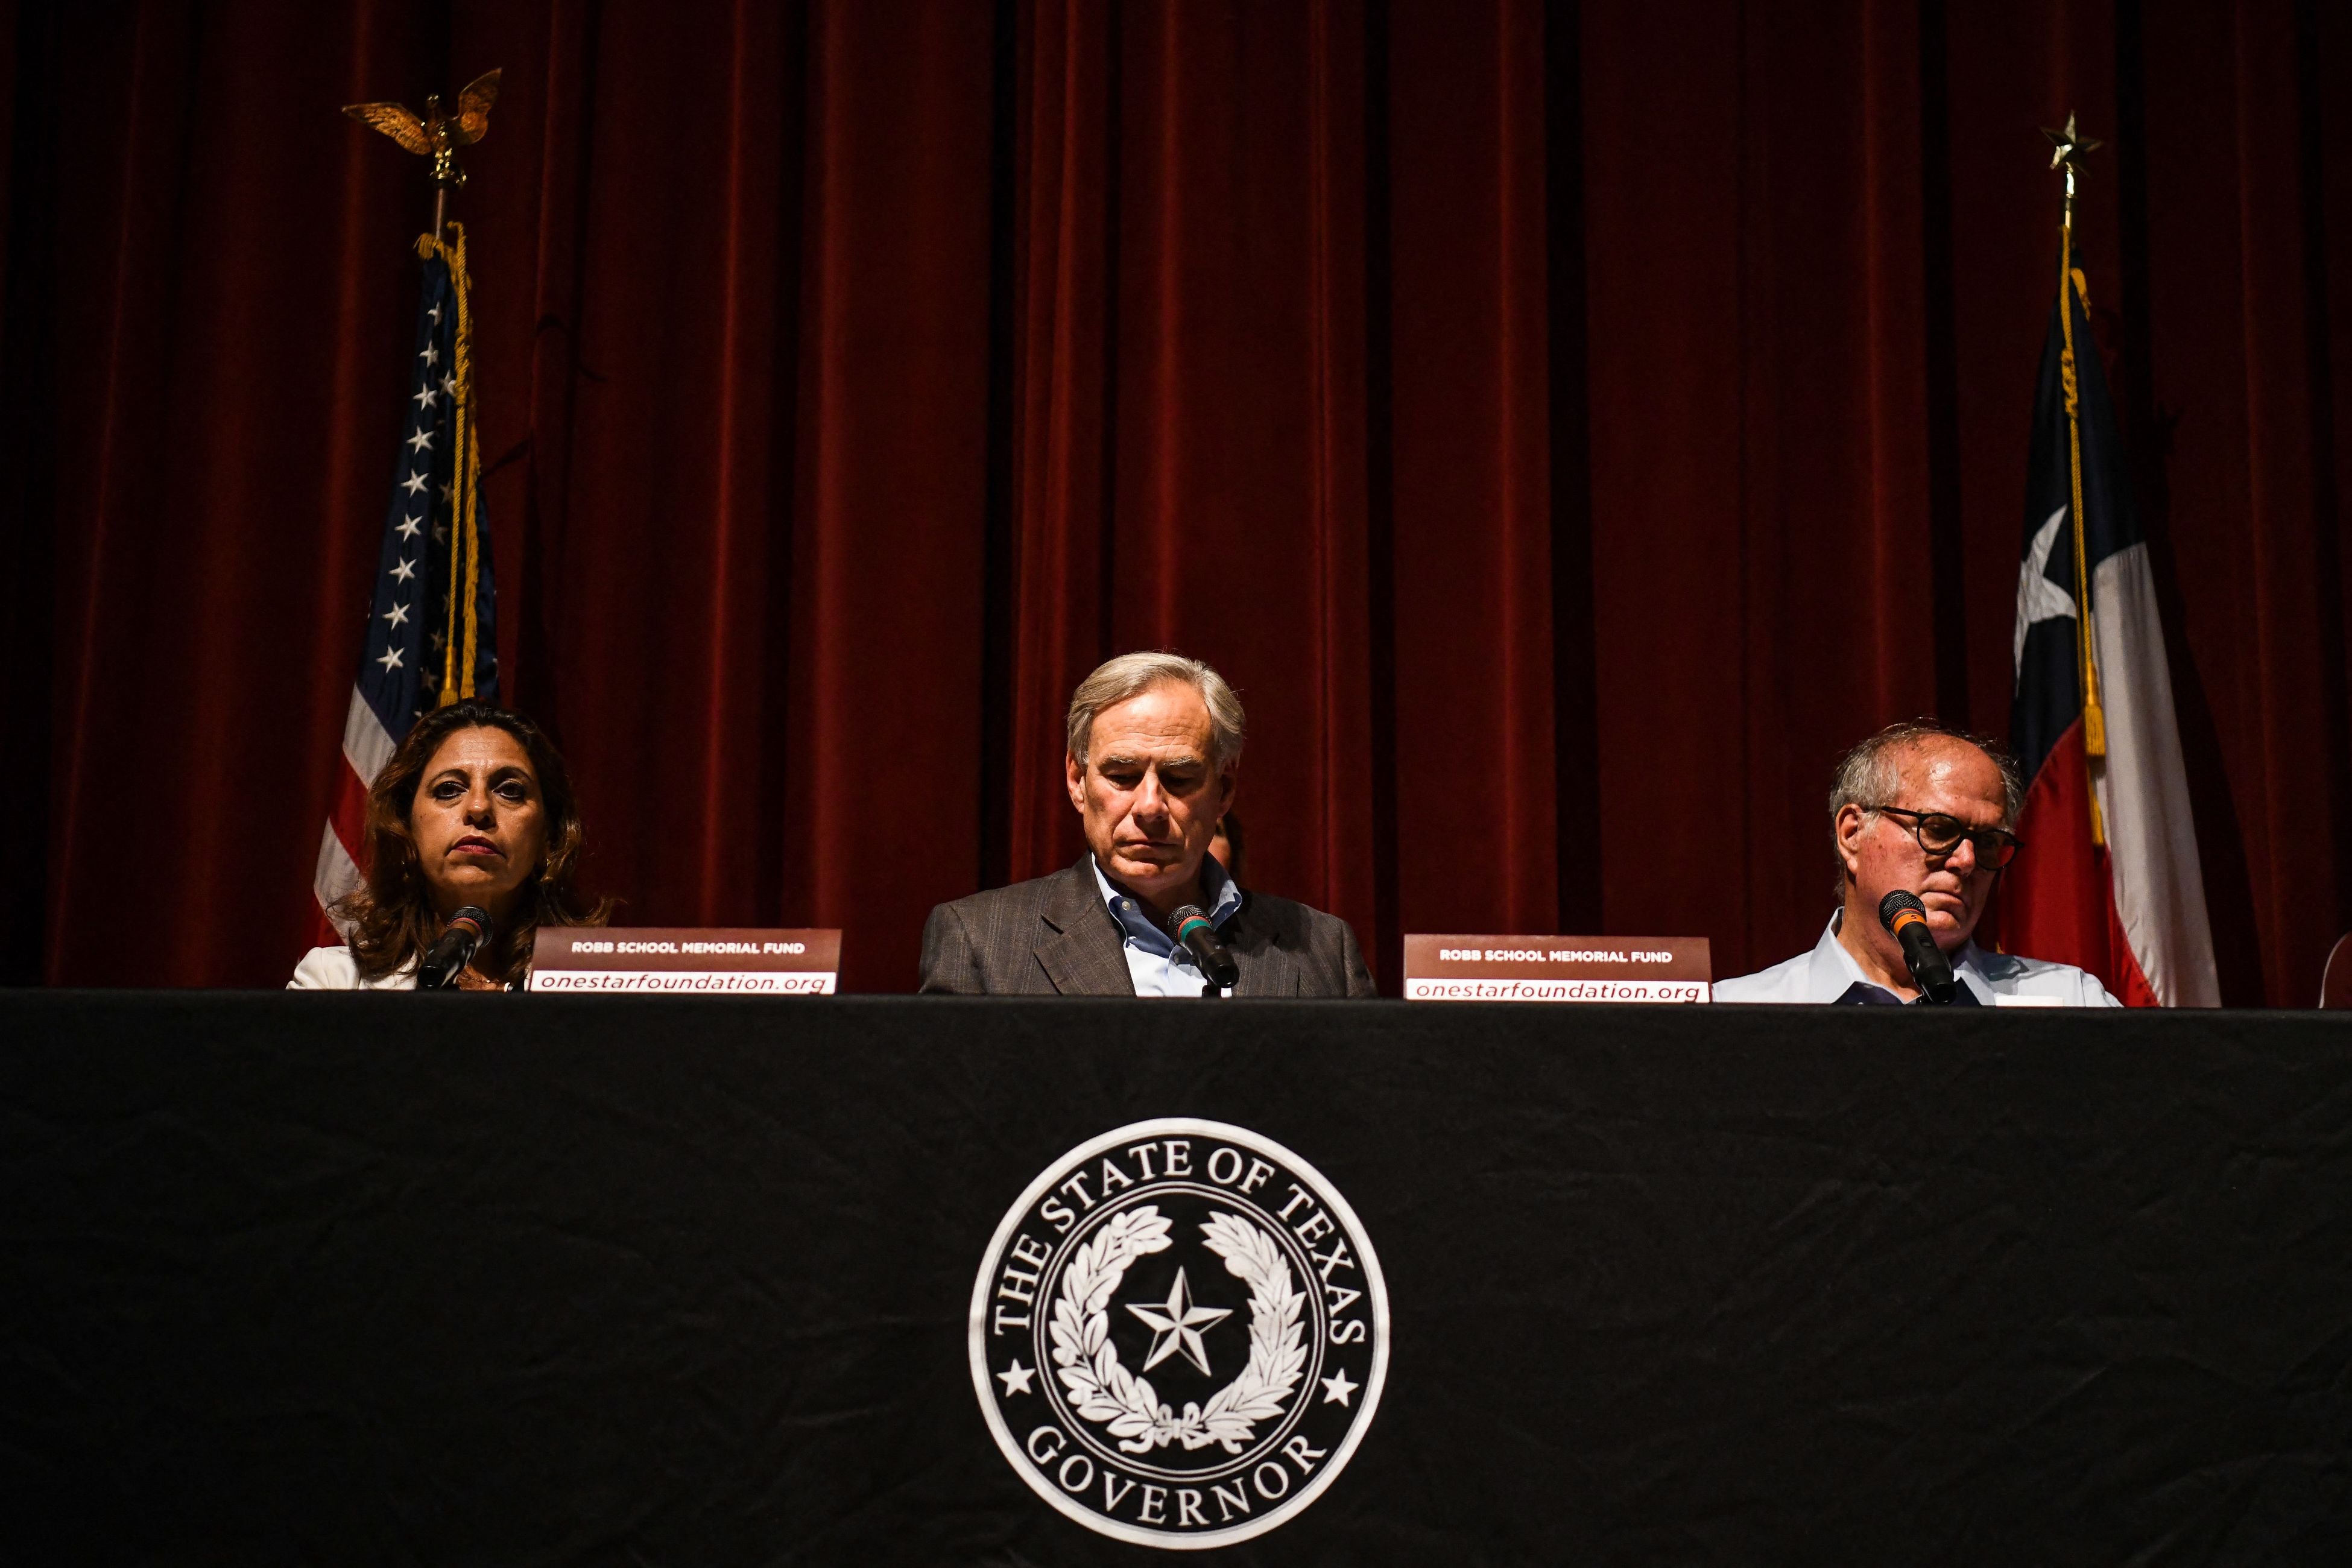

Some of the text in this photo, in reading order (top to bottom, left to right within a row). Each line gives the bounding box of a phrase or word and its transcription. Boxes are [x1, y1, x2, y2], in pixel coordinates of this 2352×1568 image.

[571, 941, 806, 955] ROBB SCHOOL MEMORIAL FUND
[1440, 949, 1673, 963] ROBB SCHOOL MEMORIAL FUND
[541, 974, 827, 993] onestarfoundation.org
[1416, 982, 1700, 1002] onestarfoundation.org
[994, 1141, 1365, 1344] THE STATE OF TEXAS
[1028, 1426, 1327, 1525] GOVERNOR
